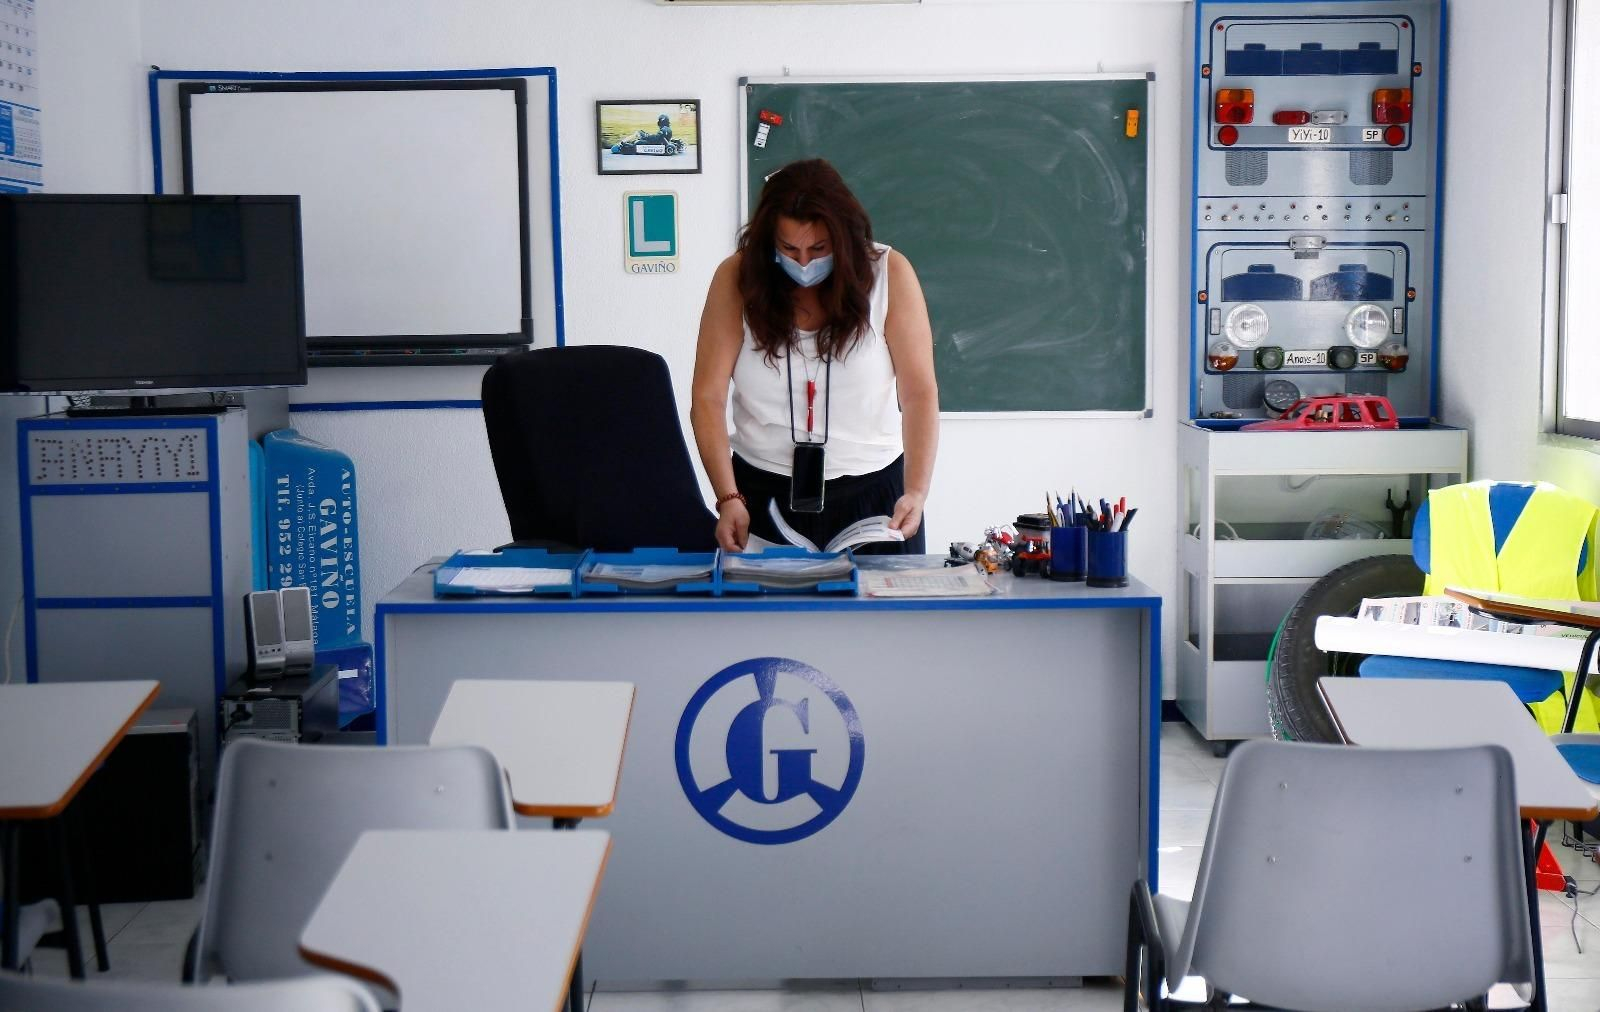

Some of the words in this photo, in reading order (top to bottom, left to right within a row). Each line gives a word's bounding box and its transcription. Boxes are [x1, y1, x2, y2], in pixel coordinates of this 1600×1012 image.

[1366, 130, 1379, 140] SP
[633, 200, 671, 252] L
[631, 260, 676, 274] GAVIÑO
[1360, 353, 1374, 363] SP
[277, 474, 291, 511] Tlf.
[278, 519, 292, 555] 952
[319, 498, 344, 609] GAVIÑO
[341, 467, 356, 636] AUTO-ESCUELA
[726, 697, 817, 805] G
